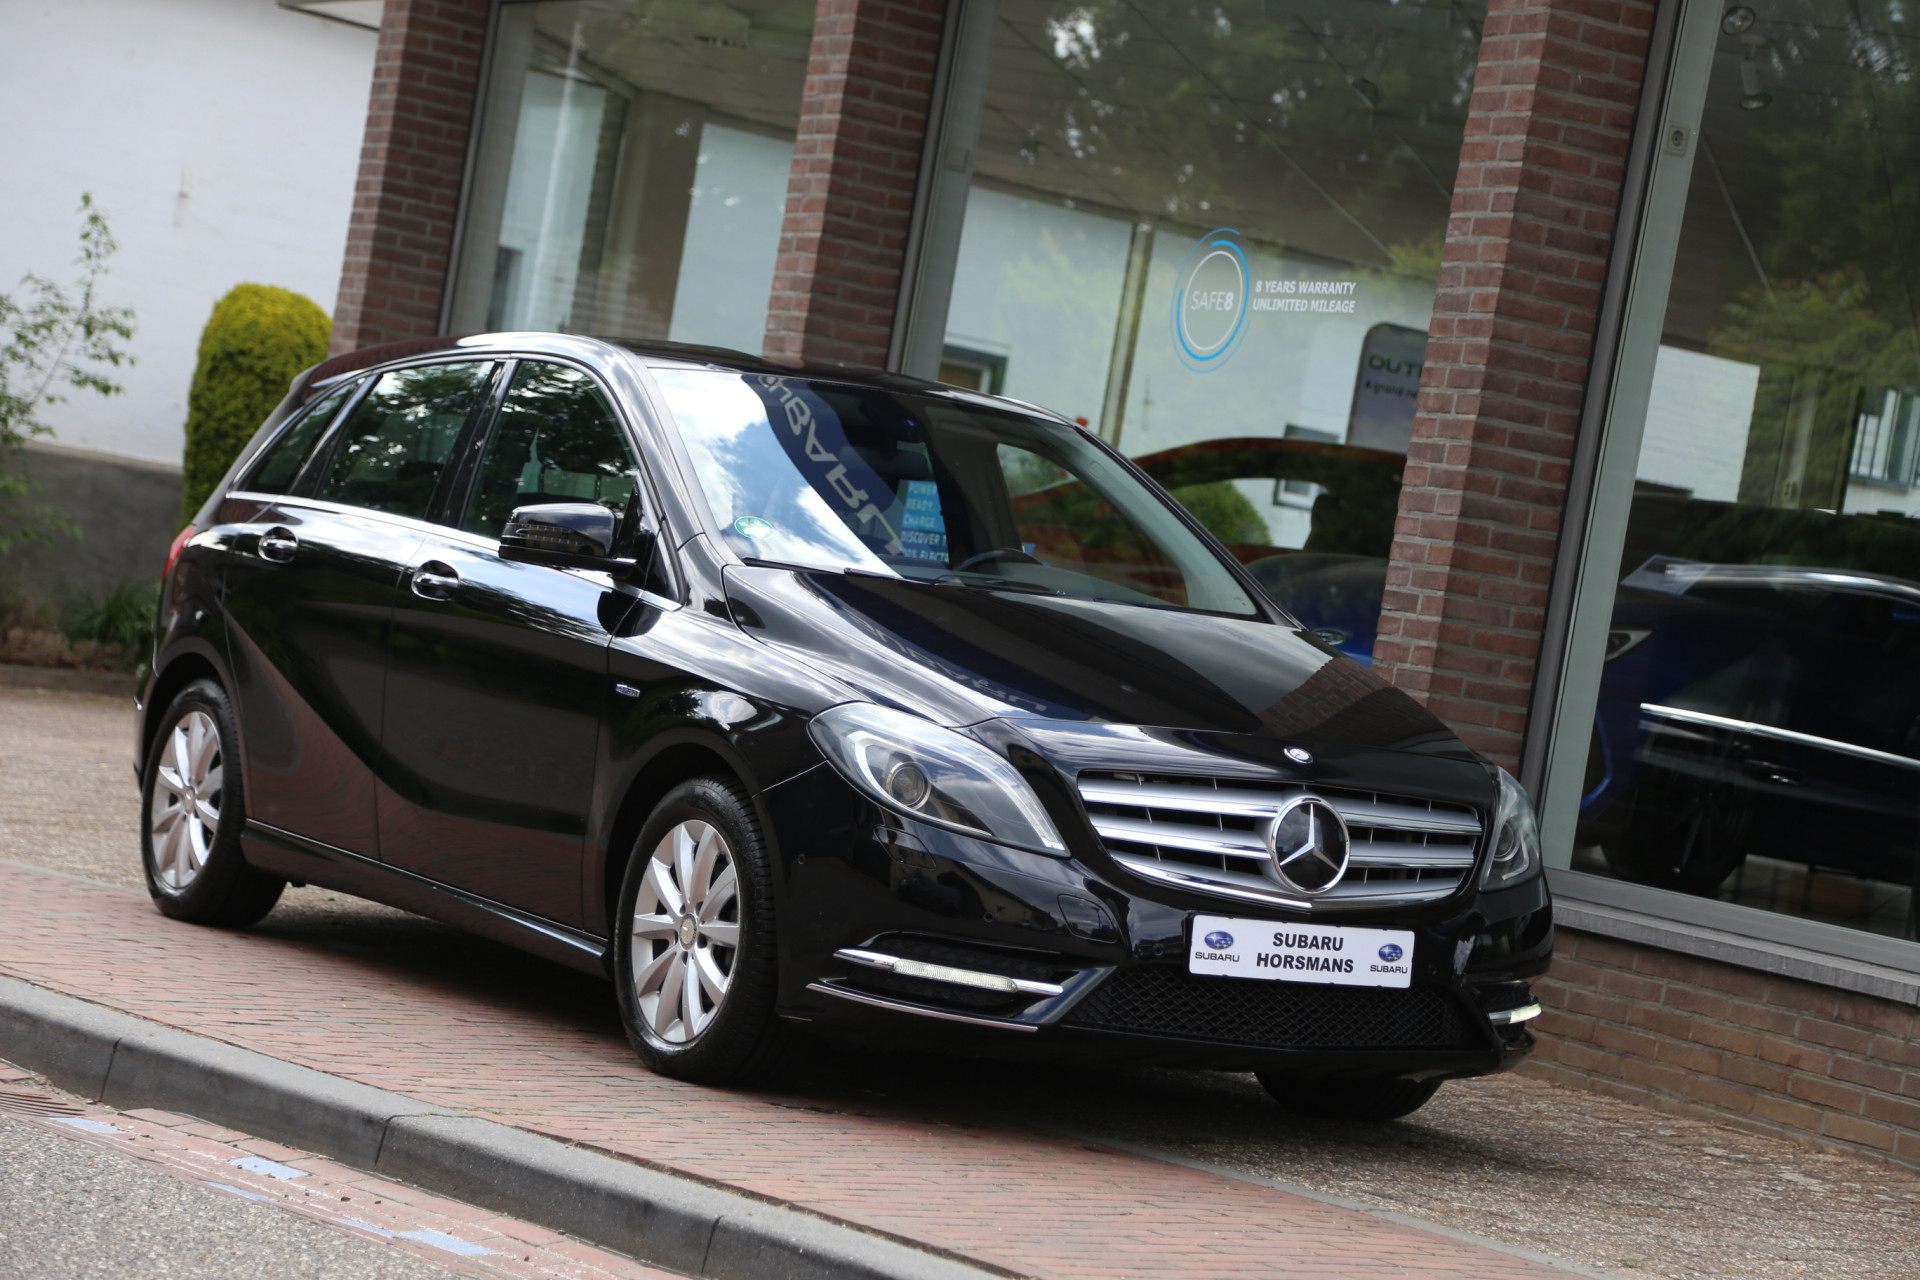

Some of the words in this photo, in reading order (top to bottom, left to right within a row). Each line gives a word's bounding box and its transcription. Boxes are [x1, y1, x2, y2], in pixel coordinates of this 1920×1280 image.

[1255, 280, 1262, 292] 8
[1265, 281, 1296, 294] YEARS
[1299, 281, 1356, 295] WARRANTY
[1191, 291, 1234, 311] SAFE8
[1252, 298, 1309, 312] UNLIMITED
[1310, 299, 1356, 313] MILEAGE
[1368, 354, 1422, 378] OUT
[900, 531, 940, 545] DISCOVER
[1272, 932, 1344, 951] SUBARU
[1195, 951, 1240, 963] SUBARU
[1256, 953, 1354, 973] HORSMANS
[1369, 964, 1409, 974] SUBARU
